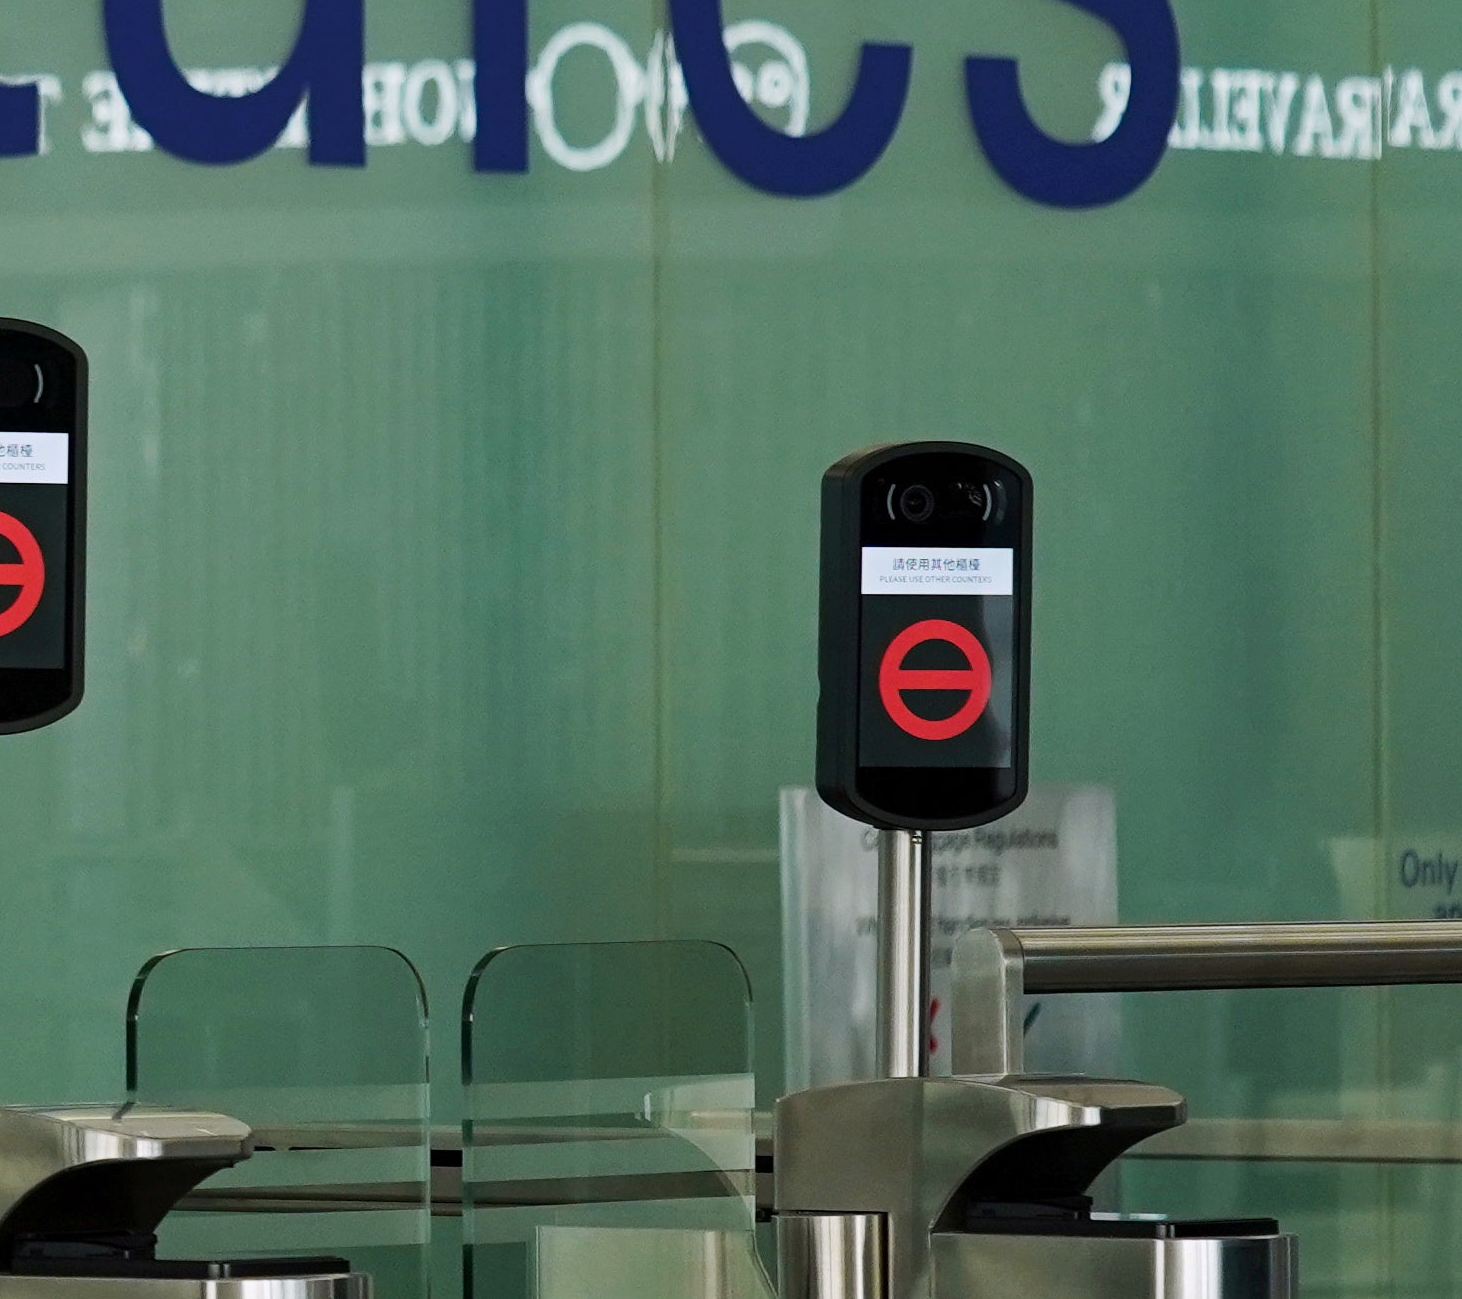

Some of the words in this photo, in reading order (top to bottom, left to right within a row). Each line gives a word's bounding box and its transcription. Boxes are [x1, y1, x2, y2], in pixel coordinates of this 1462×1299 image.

[880, 575, 907, 583] PLEASE
[909, 575, 923, 583] USE
[925, 575, 950, 583] OTHER
[1401, 849, 1459, 895] Only
